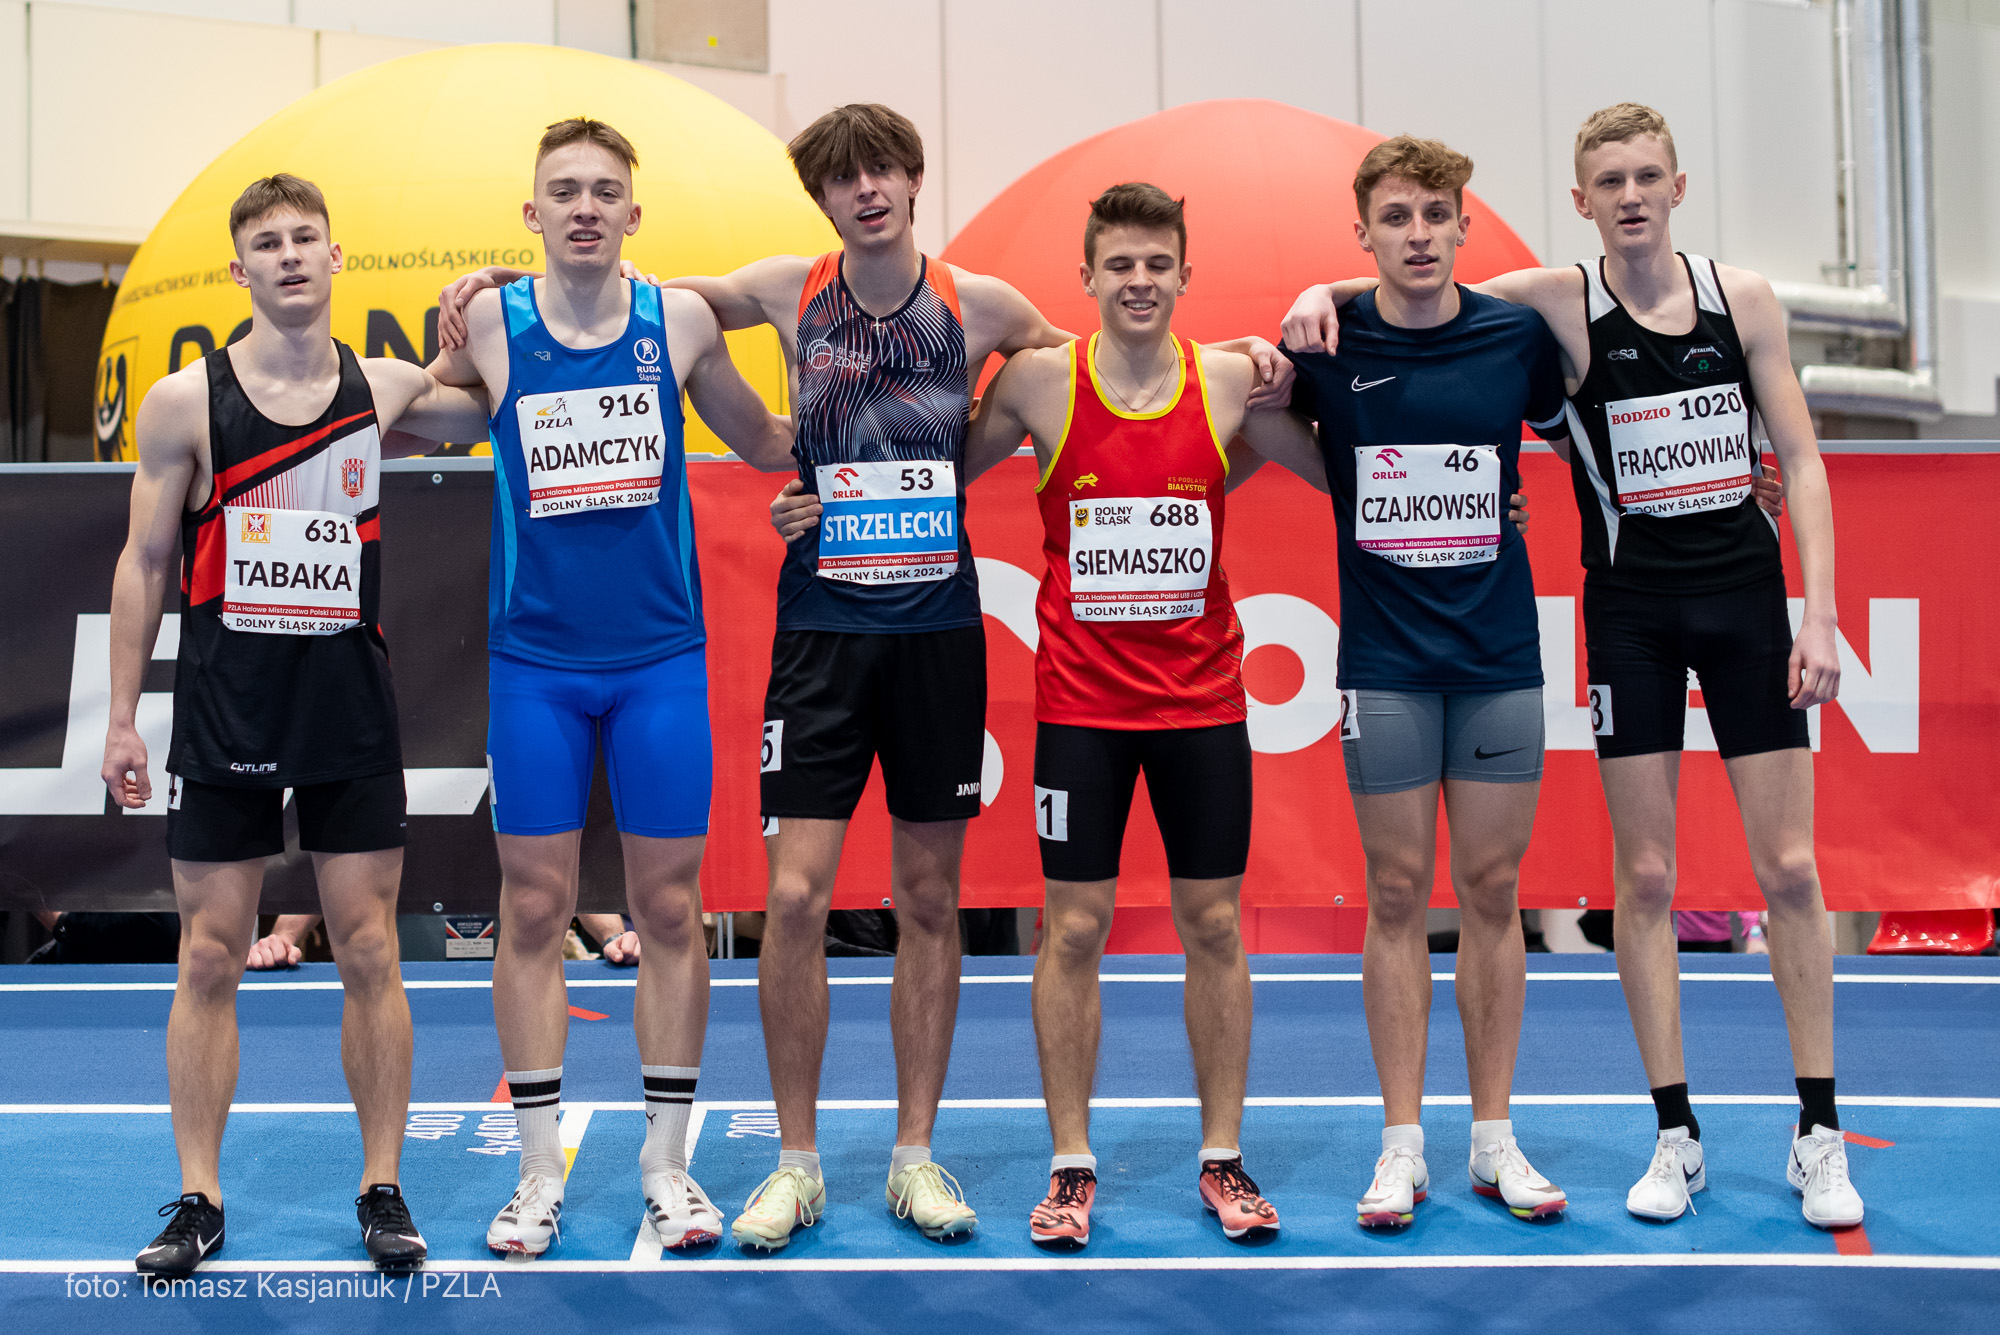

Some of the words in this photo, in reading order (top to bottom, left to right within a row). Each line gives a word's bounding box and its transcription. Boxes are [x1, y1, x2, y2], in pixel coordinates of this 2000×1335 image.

[347, 248, 534, 271] DOLNOŚLĄSKIEGO
[637, 365, 662, 374] RUDA
[835, 356, 869, 373] ZONE
[639, 373, 661, 382] Śląska
[599, 393, 650, 419] 916
[1678, 391, 1742, 421] 1020
[534, 417, 573, 430] DZLA
[1611, 407, 1671, 425] BODZIO
[530, 434, 660, 473] ADAMCZYK
[1444, 449, 1479, 473] 46
[1618, 433, 1747, 479] FRĄCKOWIAK
[900, 468, 934, 491] 53
[1372, 471, 1407, 480] ORLEN
[532, 491, 546, 499] PZLA
[546, 488, 572, 497] Halowe
[573, 483, 615, 493] Mistrzostwa
[615, 480, 636, 489] Polski
[637, 479, 648, 487] U18
[833, 489, 863, 499] ORLEN
[1168, 483, 1207, 492] BIAŁYSTOK
[1639, 491, 1664, 500] Halowe
[1665, 485, 1706, 496] Mistrzostwa
[1707, 482, 1726, 491] Polski
[542, 499, 582, 513] DOLNY
[585, 495, 624, 508] ŚLĄSK
[627, 492, 653, 502] 2024
[1361, 493, 1496, 524] CZAJKOWSKI
[1678, 496, 1716, 510] ŚLĄSK
[1719, 491, 1744, 504] 2024
[1095, 506, 1133, 516] DOLNY
[1150, 504, 1199, 527] 688
[824, 510, 953, 543] STRZELECKI
[1095, 515, 1131, 527] ŚLĄSK
[243, 532, 269, 542] PZLA
[305, 519, 352, 544] 631
[1405, 540, 1447, 548] Mistrzostwa
[837, 559, 861, 567] Halowe
[862, 556, 902, 565] Mistrzostwa
[903, 555, 923, 563] Polski
[940, 554, 954, 562] U20
[1075, 548, 1206, 576] SIEMASZKO
[1417, 551, 1455, 563] ŚLĄSK
[1458, 550, 1485, 560] 2024
[233, 559, 352, 592] TABAKA
[873, 568, 910, 581] ŚLĄSK
[914, 567, 943, 578] 2024
[1160, 592, 1179, 600] Polski
[242, 605, 267, 613] Halowe
[268, 606, 309, 615] Mistrzostwa
[310, 608, 329, 616] Polski
[1085, 607, 1126, 616] DOLNY
[1129, 604, 1167, 618] ŚLĄSK
[1170, 604, 1194, 614] 2024
[236, 618, 276, 629] DOLNY
[279, 617, 316, 632] ŚLĄSK
[319, 621, 346, 631] 2024
[1341, 694, 1351, 736] 2
[1590, 689, 1604, 731] 3
[761, 725, 773, 768] 5
[230, 762, 277, 772] CUTLINE
[1040, 793, 1052, 836] 1
[404, 1114, 466, 1140] 400
[726, 1113, 781, 1138] 200
